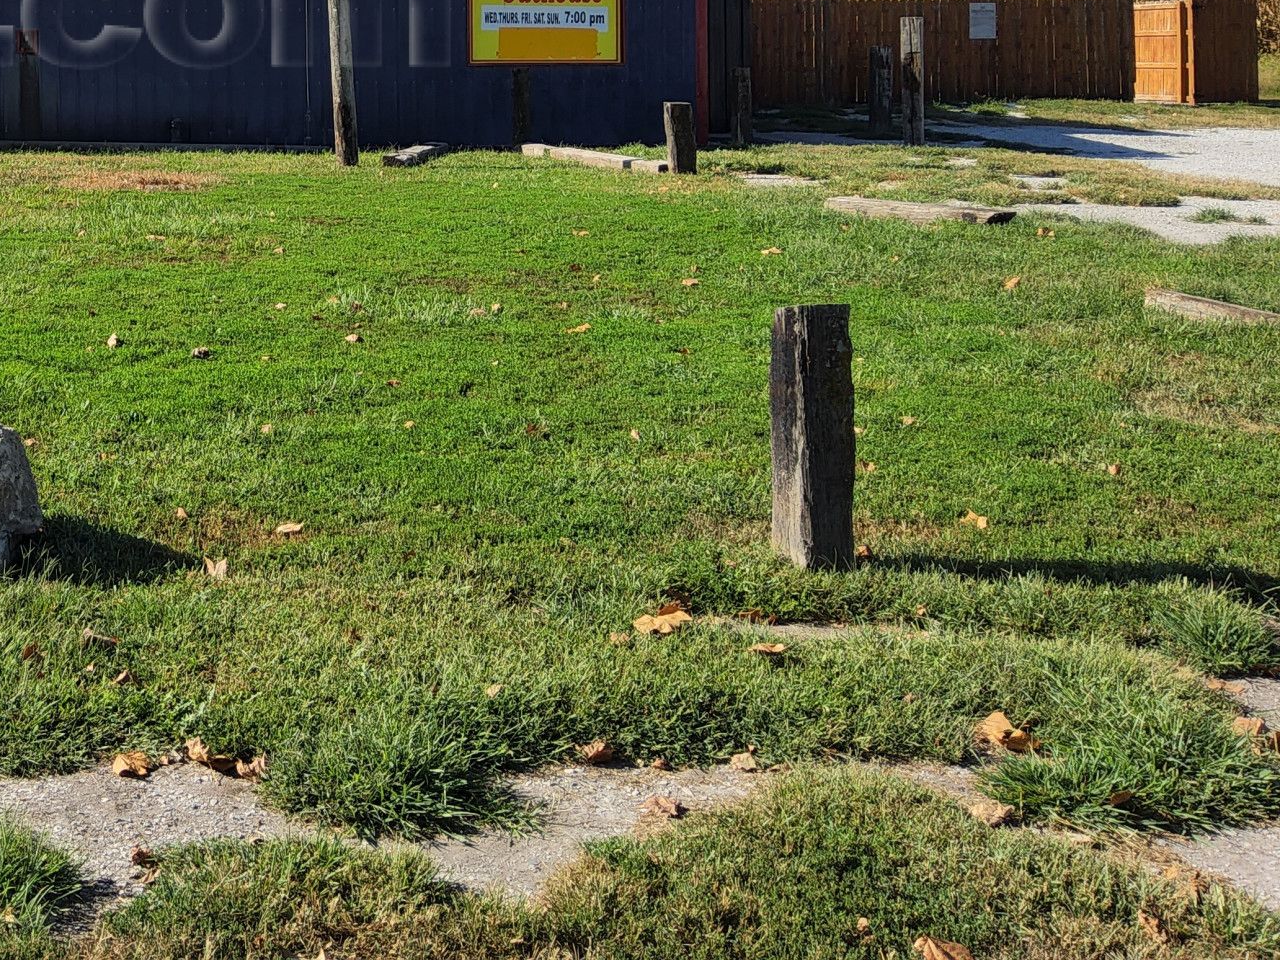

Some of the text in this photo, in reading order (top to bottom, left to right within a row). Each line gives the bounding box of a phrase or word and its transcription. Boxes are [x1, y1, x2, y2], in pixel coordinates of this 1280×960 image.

[521, 12, 533, 24] FRI.
[533, 13, 546, 24] SAT.
[547, 13, 561, 24] SUN.
[564, 11, 587, 24] 7:00
[589, 15, 605, 26] pm
